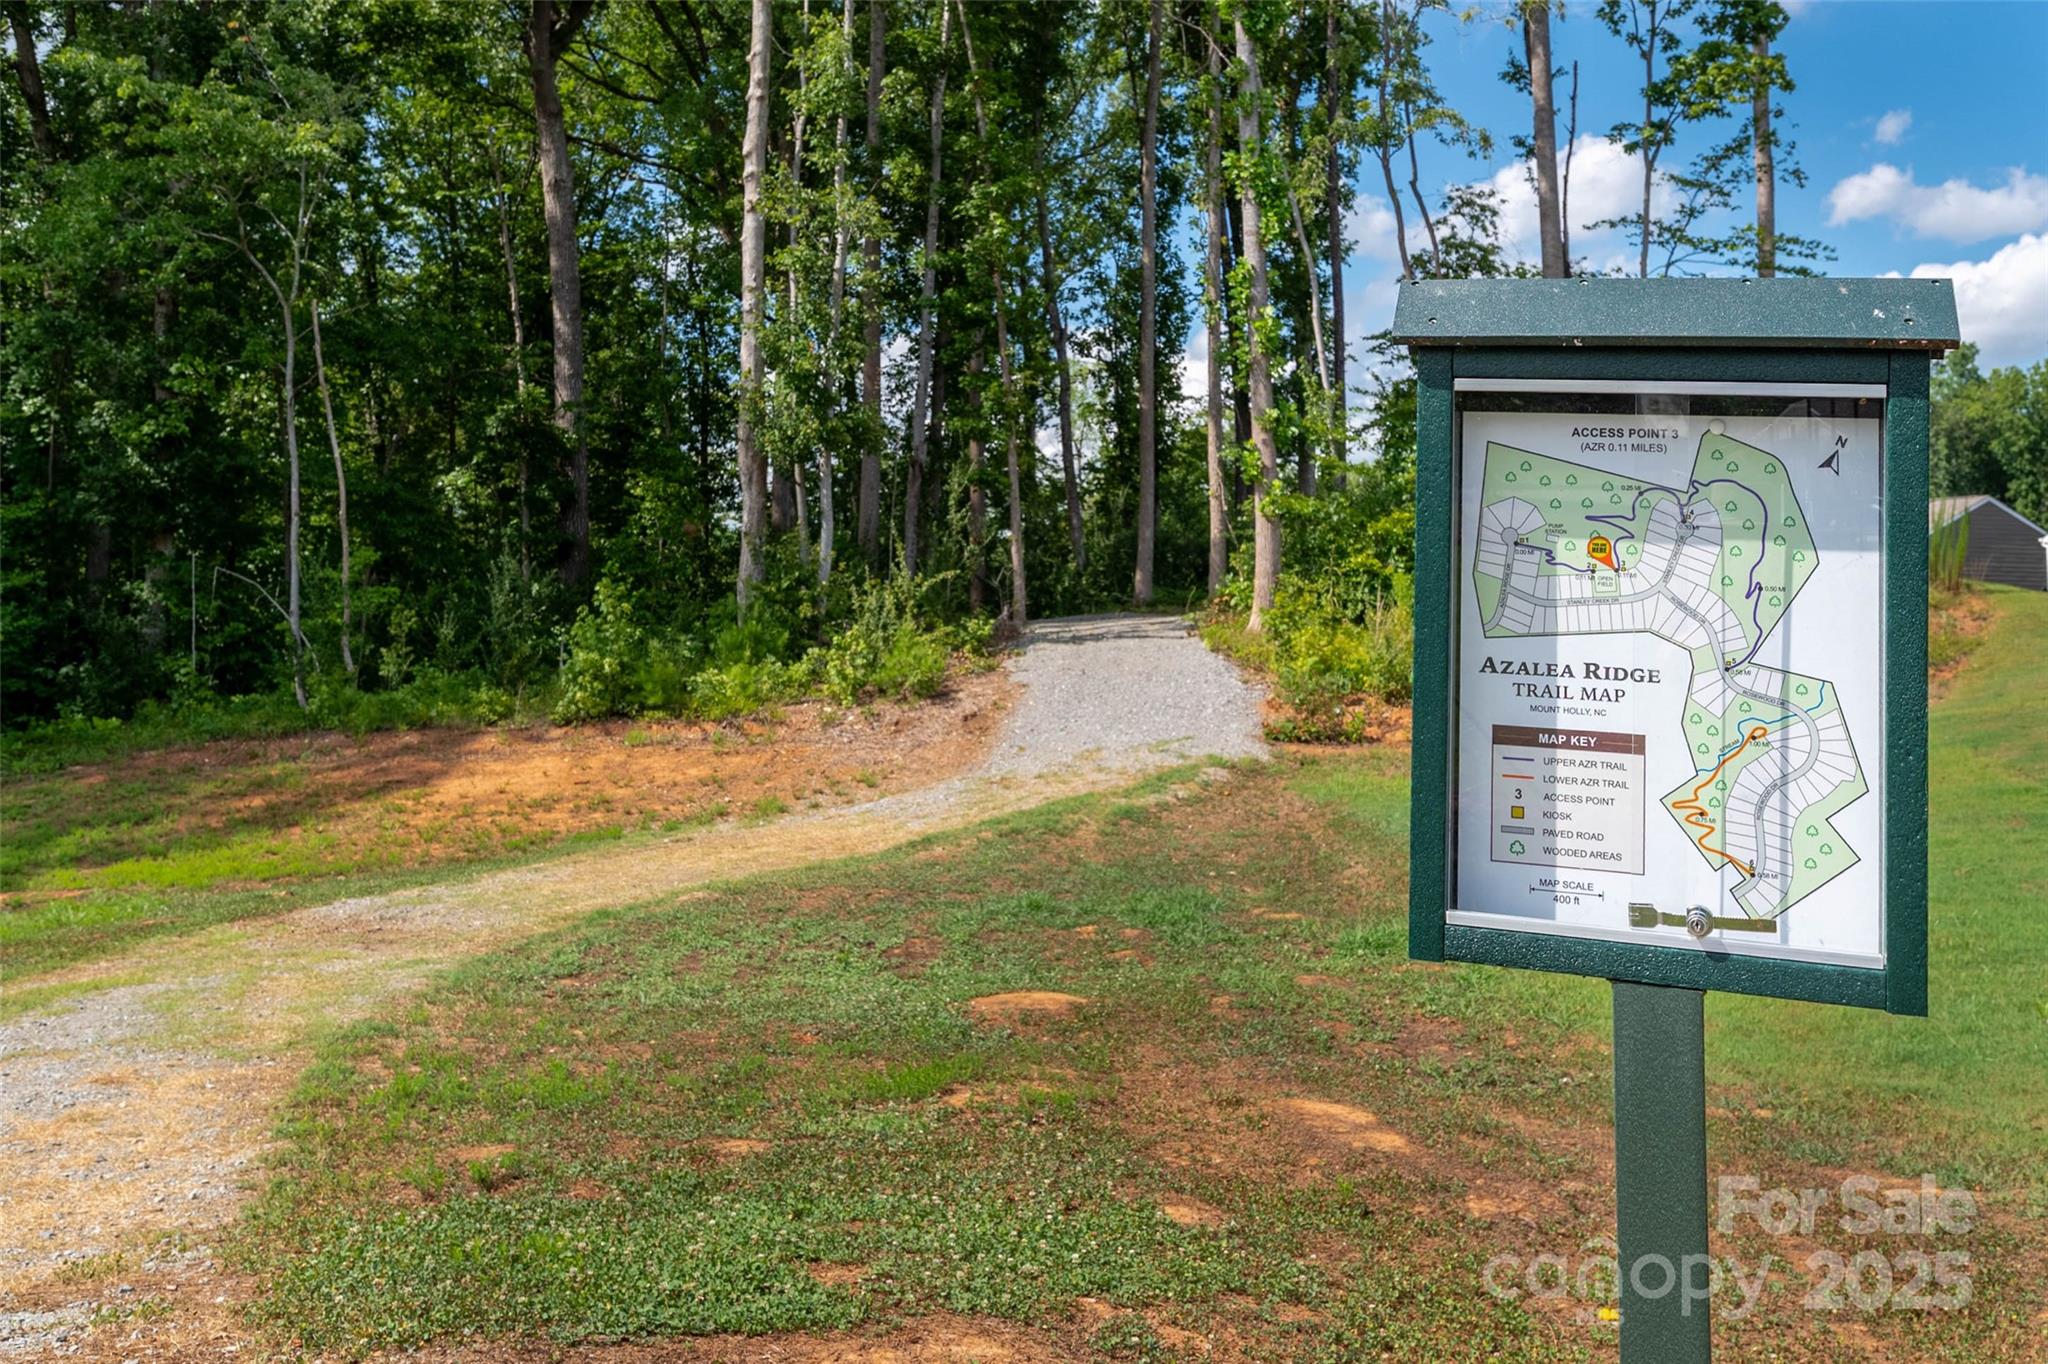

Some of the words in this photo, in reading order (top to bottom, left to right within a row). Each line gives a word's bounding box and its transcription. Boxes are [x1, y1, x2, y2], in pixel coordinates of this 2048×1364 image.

[1571, 427, 1624, 438] ACCESS
[1629, 428, 1668, 439] POINT
[1672, 429, 1679, 439] 3
[1580, 442, 1606, 453] (AZR
[1608, 443, 1628, 452] 0.11
[1631, 443, 1668, 454] MILES)
[1835, 435, 1848, 448] N
[1479, 656, 1575, 678] AZALEA
[1583, 662, 1661, 684] RIDGE
[1512, 682, 1574, 700] TRAIL
[1580, 687, 1626, 703] MAP
[1530, 704, 1561, 714] MOUNT
[1563, 706, 1592, 716] HOLLY,
[1594, 708, 1607, 716] NC
[1538, 732, 1567, 745] MAP
[1570, 735, 1597, 747] KEY
[1543, 757, 1576, 768] UPPER
[1578, 759, 1598, 769] AZR
[1601, 761, 1627, 771] TRAIL
[1543, 775, 1580, 786] LOWER
[1580, 778, 1600, 788] AZR
[1602, 780, 1630, 790] TRAIL
[1514, 788, 1522, 800] 3
[1543, 793, 1584, 804] ACCESS
[1586, 796, 1616, 806] POINT
[1542, 810, 1572, 821] KIOSK
[1542, 828, 1574, 840] PAVED
[1576, 832, 1604, 842] ROAD
[1542, 846, 1588, 858] WOODED
[1588, 851, 1622, 862] AREAS
[1539, 878, 1560, 888] MAP
[1562, 880, 1594, 892] SCALE
[1552, 894, 1572, 904] 400
[1574, 896, 1580, 905] ft
